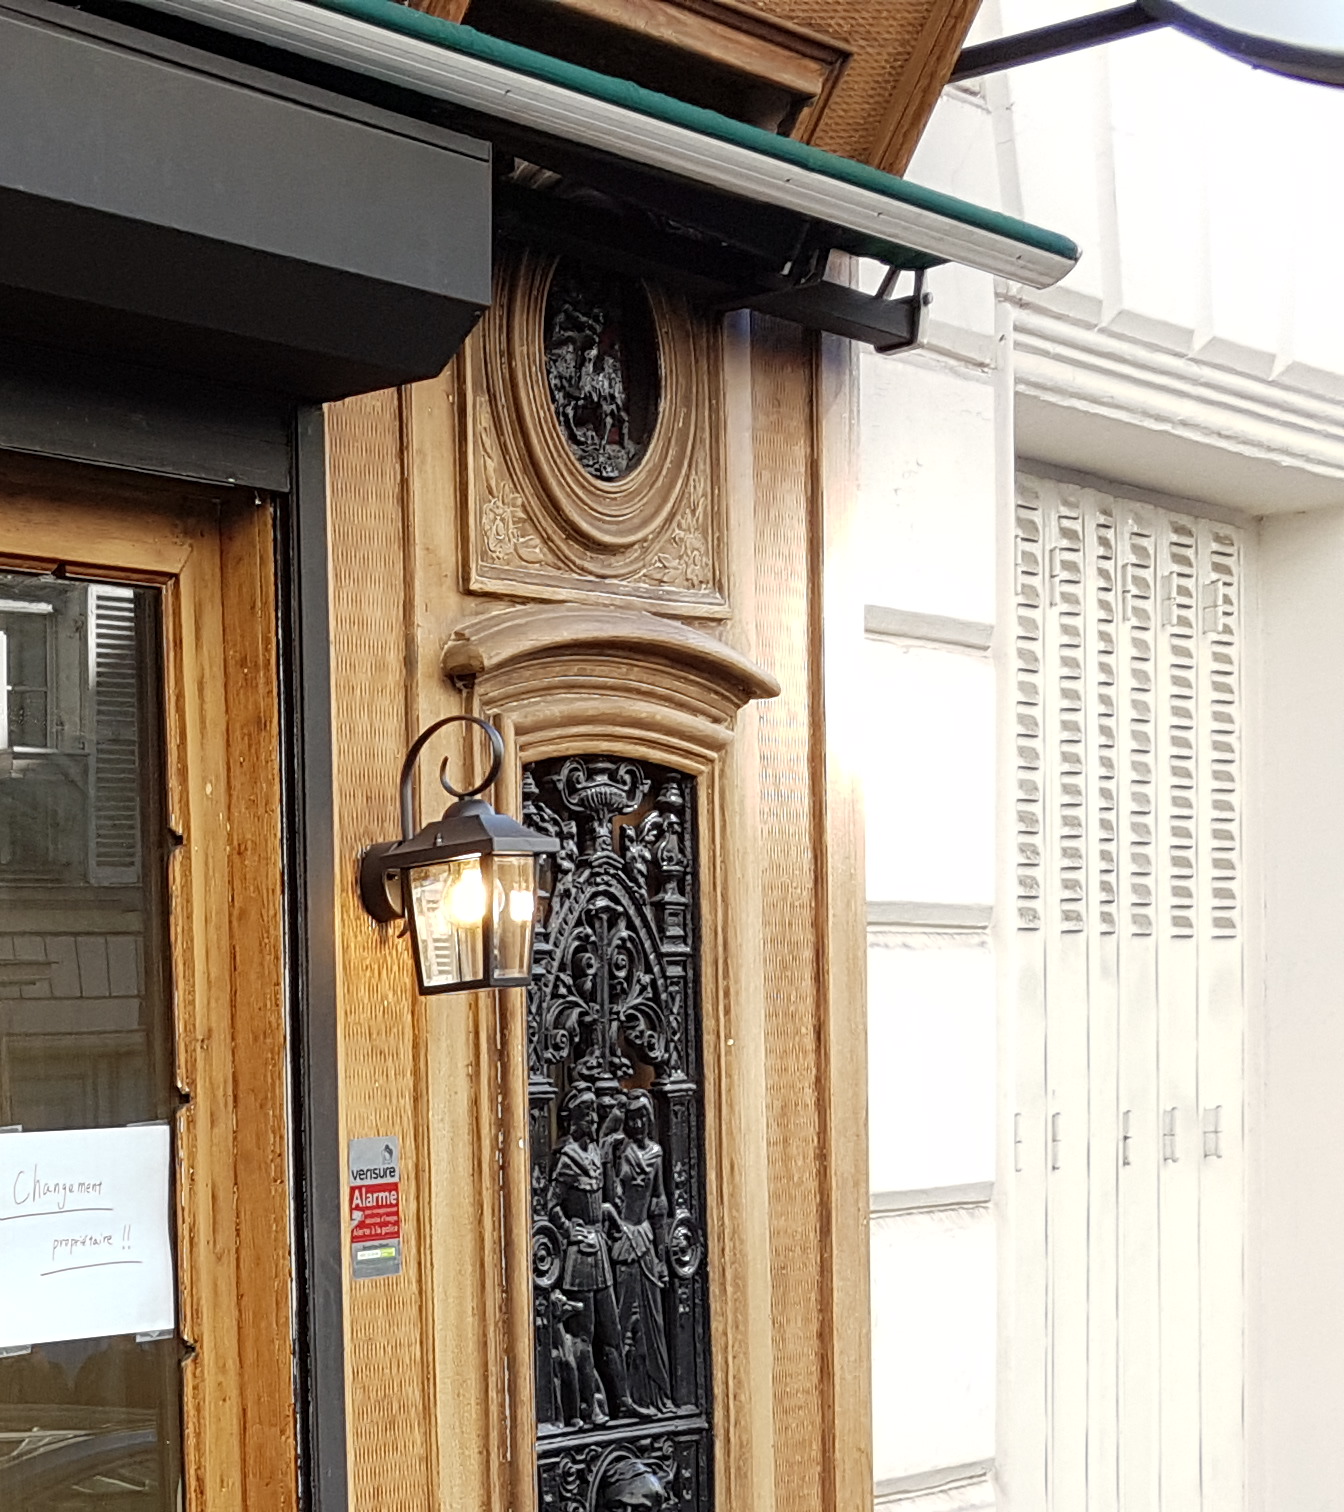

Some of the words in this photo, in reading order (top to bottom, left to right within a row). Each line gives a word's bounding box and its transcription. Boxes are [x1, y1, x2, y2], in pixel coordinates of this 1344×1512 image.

[351, 1166, 396, 1181] verisure
[14, 1164, 103, 1210] Changement
[352, 1187, 398, 1208] Alarme
